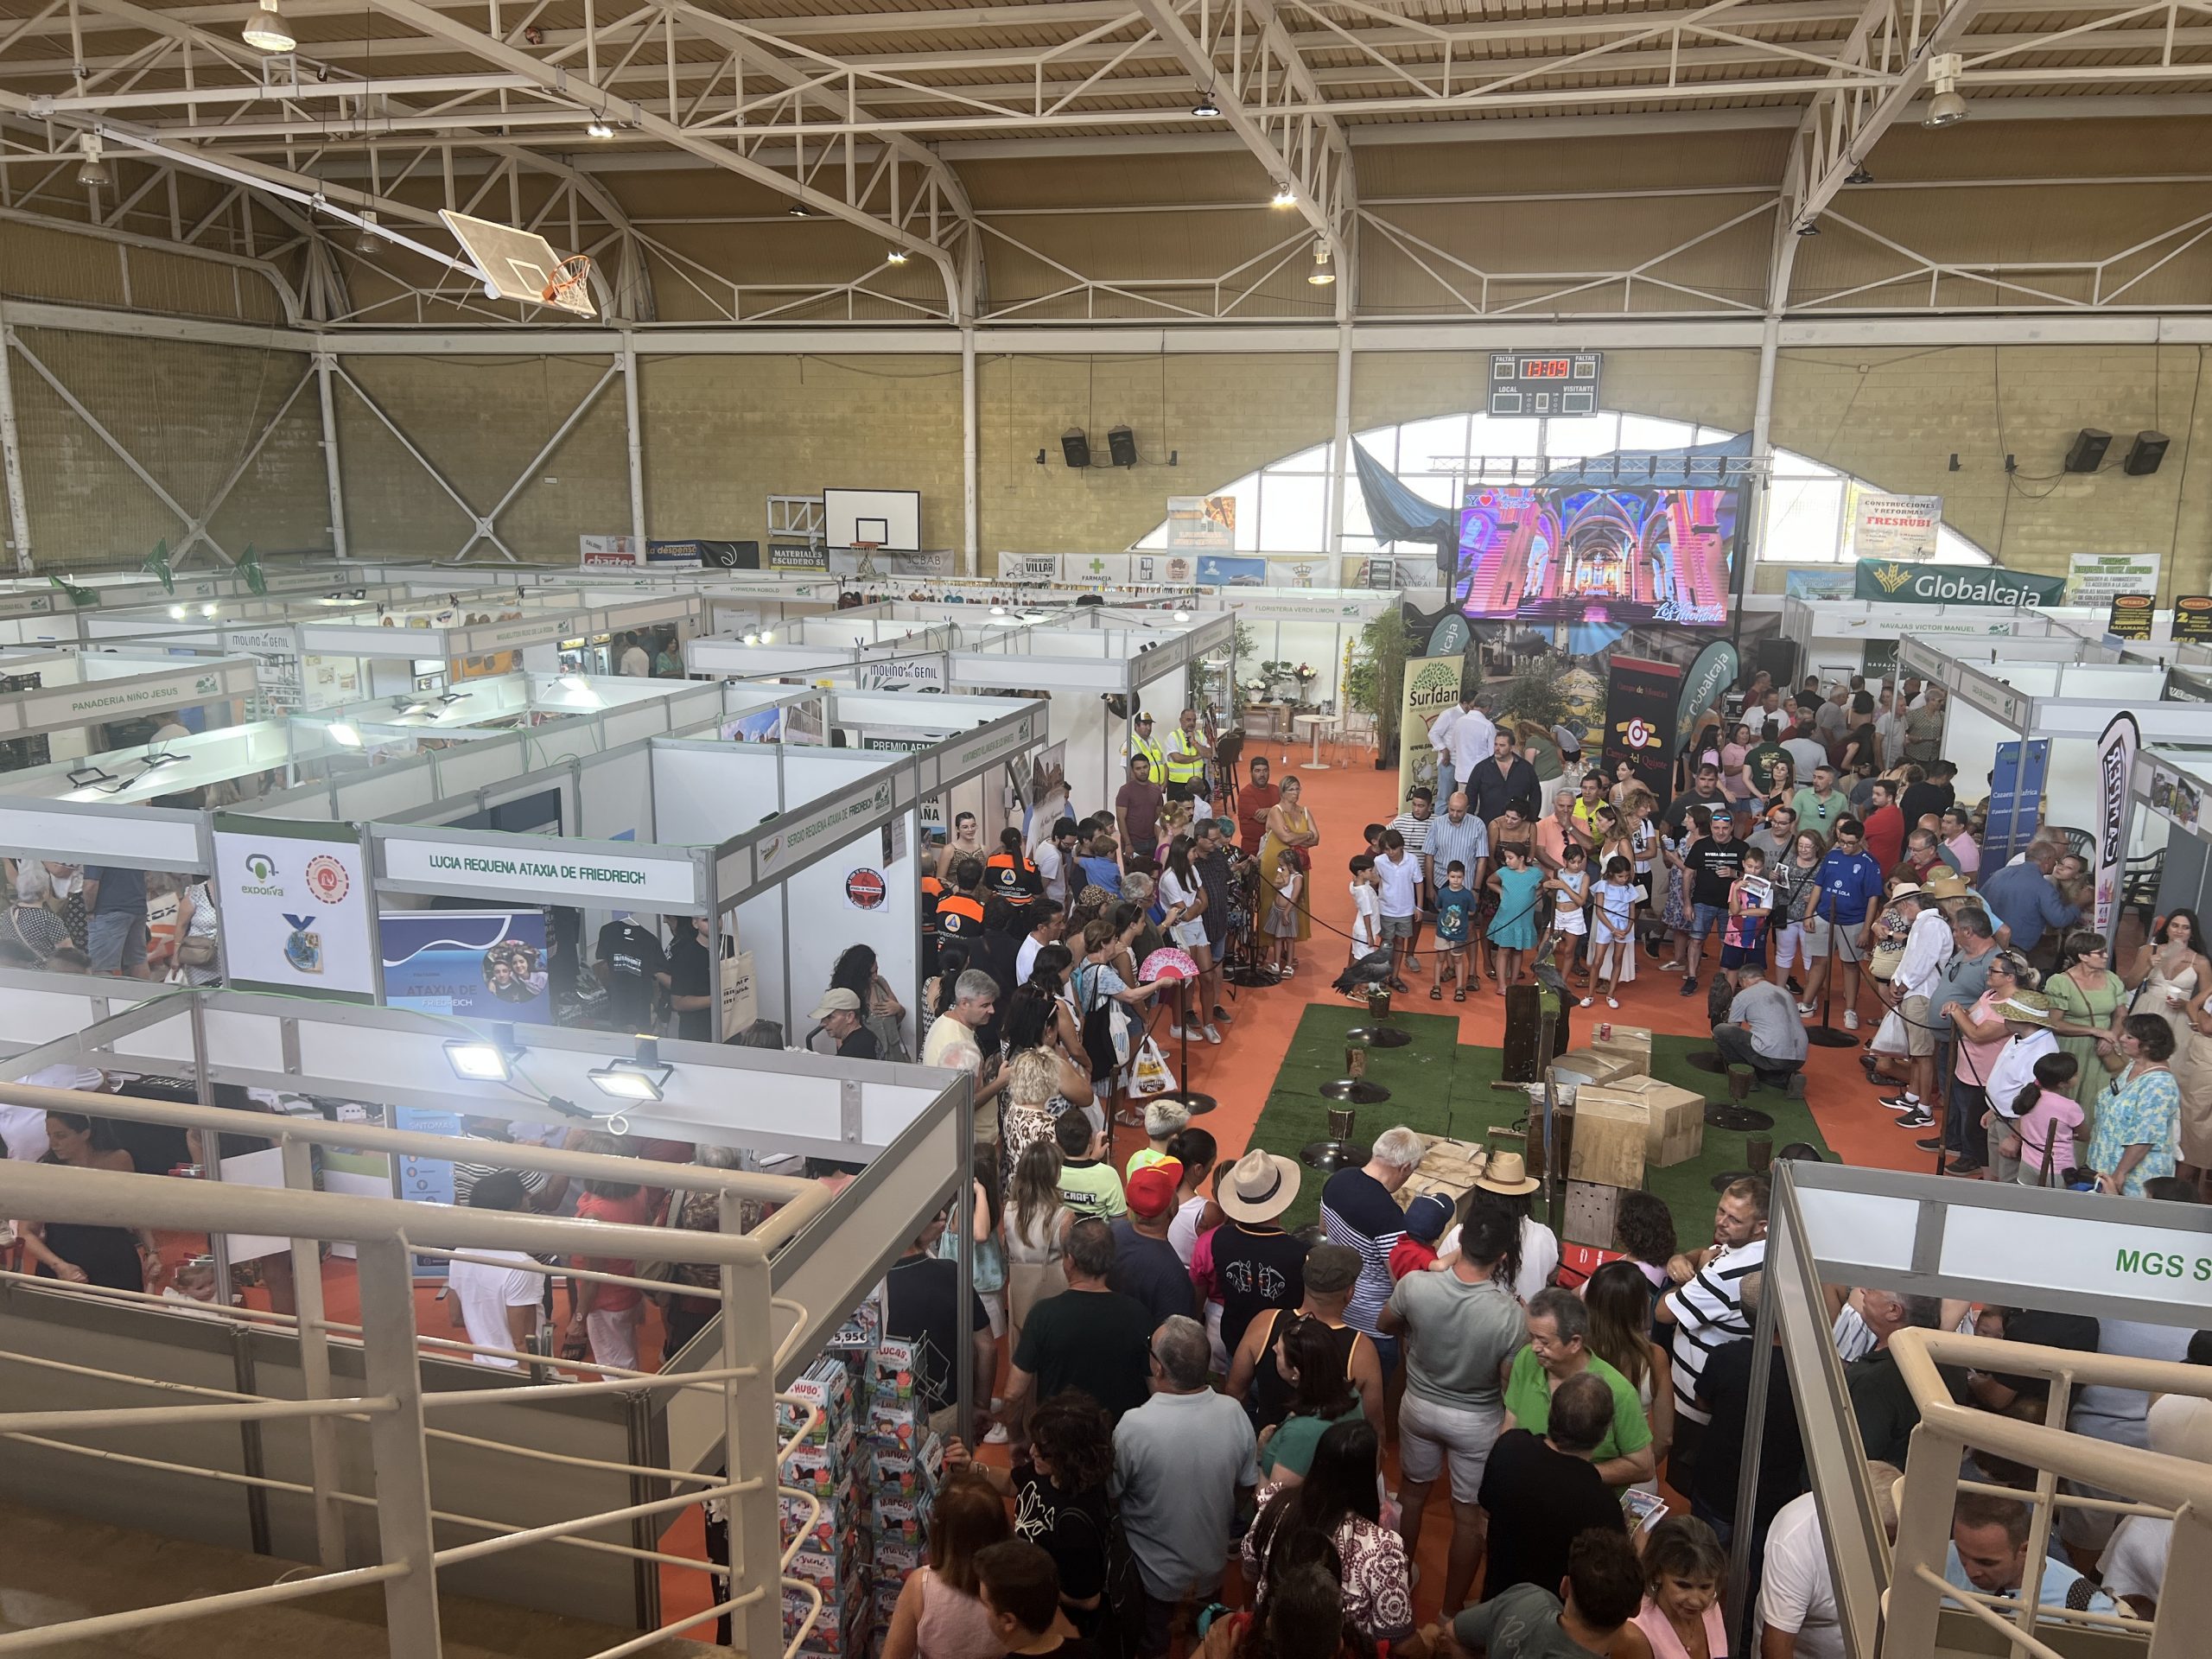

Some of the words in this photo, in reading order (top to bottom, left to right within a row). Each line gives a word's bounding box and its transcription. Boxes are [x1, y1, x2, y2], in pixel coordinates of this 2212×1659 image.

[1528, 360, 1567, 377] 13:09
[1865, 500, 1935, 509] CONSTRUCCIONES
[588, 555, 635, 565] charter
[774, 550, 823, 558] MATERIALES
[1026, 563, 1052, 572] VILLAR
[1915, 575, 2040, 607] Globalcaja
[2177, 612, 2189, 622] 2
[232, 635, 261, 646] MOLINO
[270, 637, 289, 648] GENIL
[1440, 623, 1459, 655] lcaja
[870, 664, 903, 677] MOLINO
[914, 666, 938, 679] GENIL
[1689, 652, 1729, 715] Globalcaja
[72, 696, 124, 711] PANADERIA
[151, 687, 178, 698] JESUS
[1409, 687, 1459, 707] Suridan
[873, 741, 908, 752] PREMIO
[787, 829, 805, 848] SERGIO
[805, 817, 827, 838] REQUENA
[827, 810, 842, 829] ATAXIA
[842, 808, 849, 821] DE
[429, 855, 461, 869] LUCIA
[464, 858, 517, 874] REQUENA
[519, 862, 558, 878] ATAXIA
[561, 865, 576, 880] DE
[579, 868, 645, 885] FRIEDREICH
[241, 884, 284, 898] expoliva
[407, 984, 456, 996] ATAXIA
[459, 984, 478, 995] DE
[1061, 1191, 1096, 1203] CRAFT
[2115, 1249, 2183, 1279] MGS
[834, 1332, 868, 1343] 5,95€
